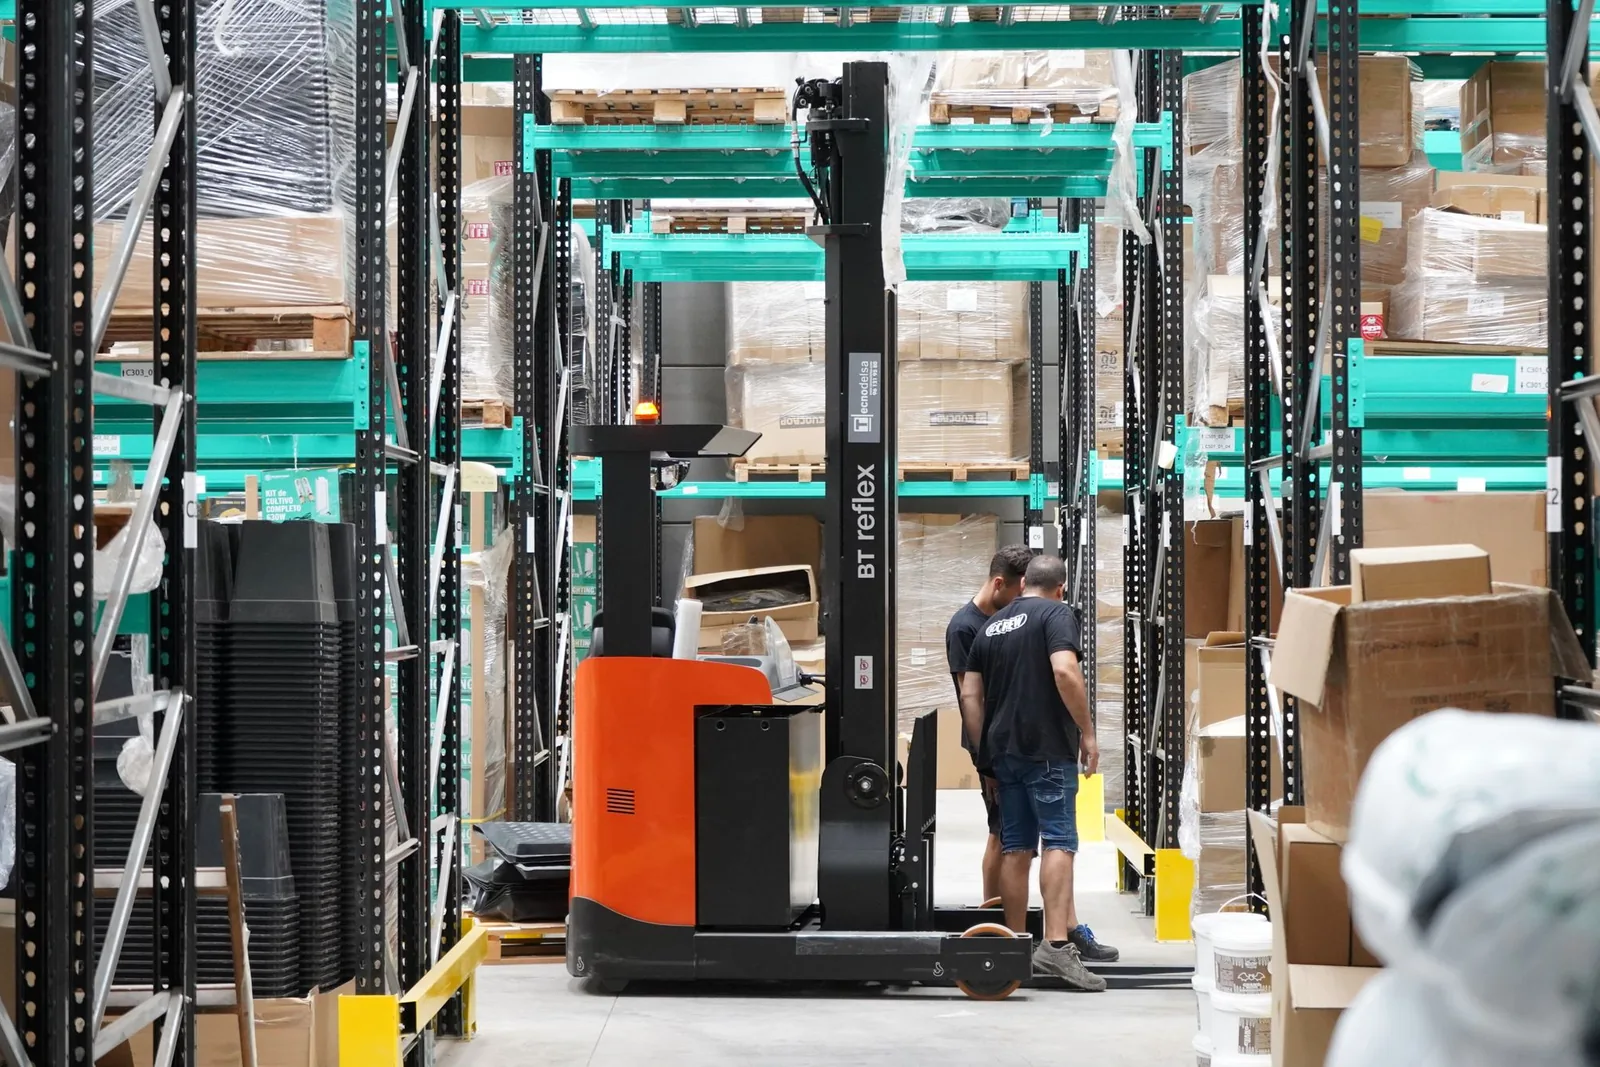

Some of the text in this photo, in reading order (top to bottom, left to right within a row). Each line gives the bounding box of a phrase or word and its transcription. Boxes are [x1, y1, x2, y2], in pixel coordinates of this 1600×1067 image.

[265, 489, 287, 497] KIT de
[265, 497, 294, 505] CULTIVO
[266, 504, 302, 513] COMPLETO
[852, 464, 875, 578] BT reflex
